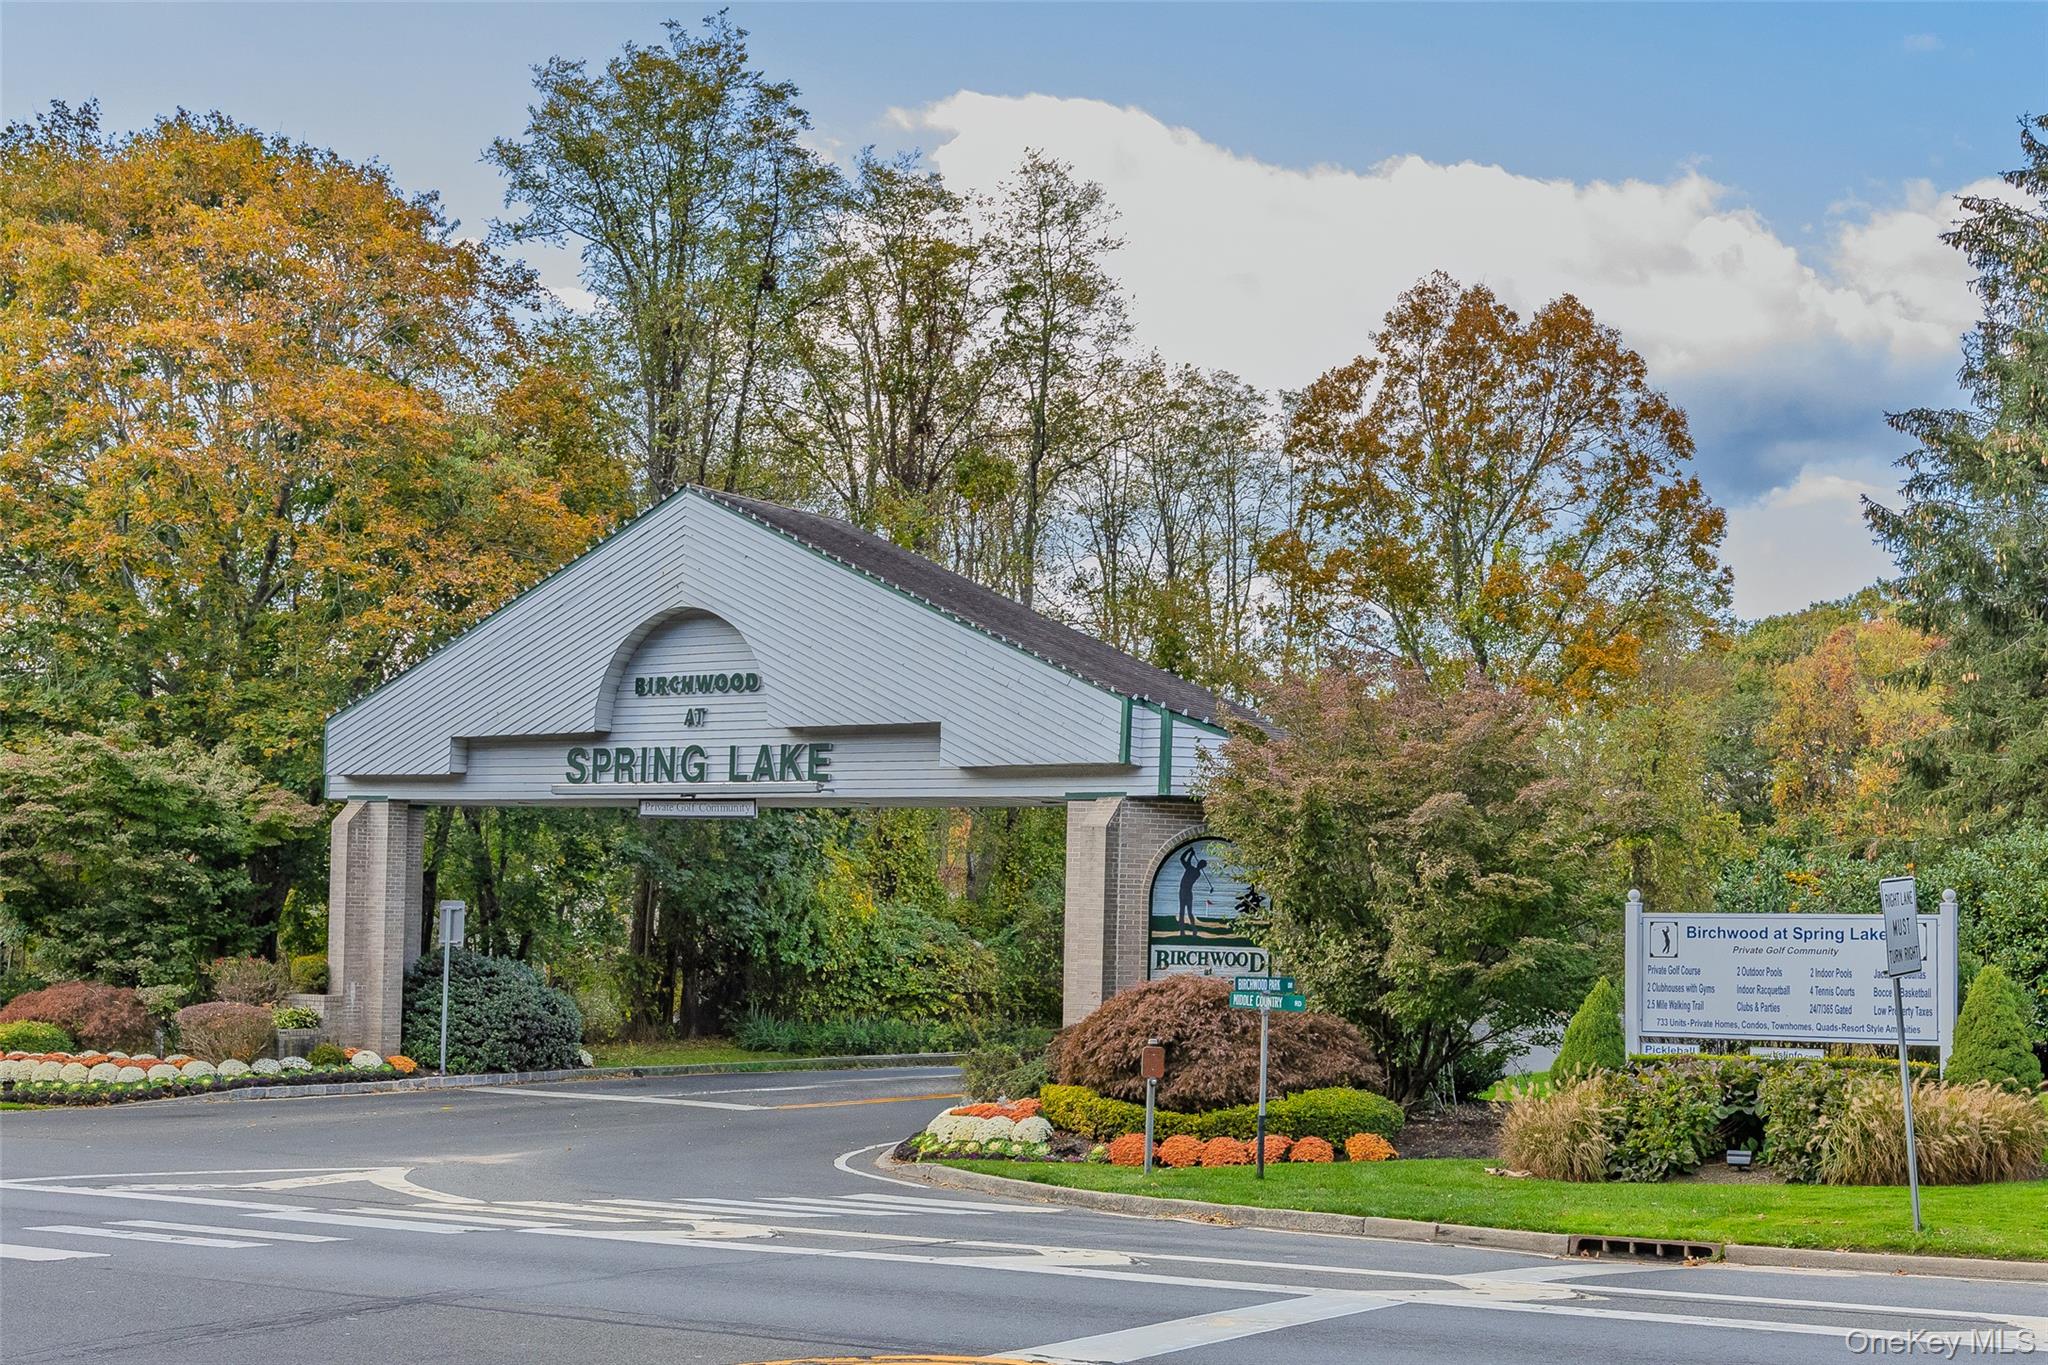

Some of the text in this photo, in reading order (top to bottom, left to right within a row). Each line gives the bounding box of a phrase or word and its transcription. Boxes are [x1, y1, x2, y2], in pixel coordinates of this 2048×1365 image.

[635, 672, 761, 696] BIRCHWOOD
[683, 706, 708, 727] AT
[565, 742, 833, 784] SPRING LAKE
[645, 801, 751, 815] Private Golf Community
[1885, 891, 1914, 908] RIGHT LANE
[1892, 917, 1911, 937] MUST
[1686, 926, 1887, 943] Birchwood at Spring Lake
[1732, 945, 1840, 957] Private Golf Community
[1889, 945, 1919, 964] TURN RIGHT
[1154, 949, 1266, 973] BIRCHWOOD
[1647, 965, 1701, 976] Private Golf Course
[1736, 966, 1783, 978] 2 Outdoor Pools
[1810, 967, 1853, 979] 2 Indoor Pools
[1237, 978, 1268, 991] BIRCHWOOD
[1268, 979, 1281, 991] PARK
[1647, 982, 1716, 996] 2 Clubhouses with Gyms
[1736, 984, 1791, 997] Indoor Racquetball
[1809, 986, 1856, 997] 4 Tennis Courts
[1873, 986, 1932, 999] Bocce Basketball
[1233, 994, 1254, 1007] MIDDLE
[1255, 995, 1283, 1009] COUNTRY
[1646, 999, 1705, 1012] 2.5 Mile Walking Trail
[1736, 1002, 1780, 1013] Clubs & Parties
[1809, 1004, 1853, 1015] 24/7/365 Gated
[1873, 1005, 1933, 1019] Low Prerty Taxes
[1656, 1018, 1668, 1027] 733
[1714, 1020, 1740, 1030] Homes,
[1741, 1020, 1769, 1031] Condos,
[1771, 1021, 1814, 1032] Townhomes,
[1866, 1023, 1884, 1035] Style
[1885, 1024, 1921, 1034] Amities
[1644, 1044, 1696, 1054] Pickleball
